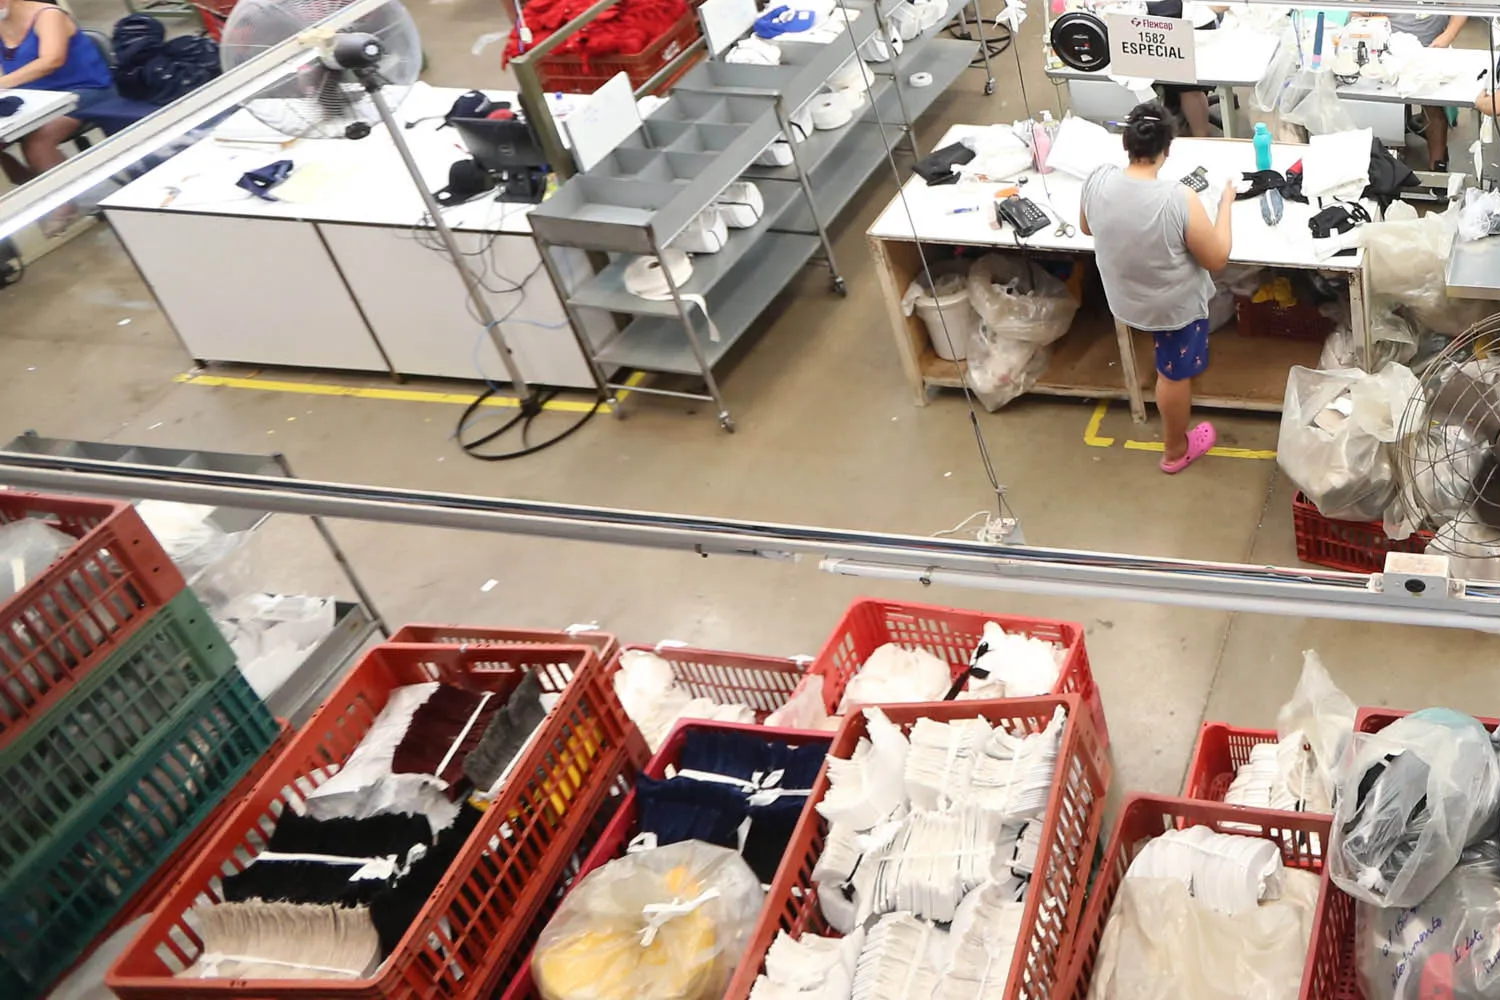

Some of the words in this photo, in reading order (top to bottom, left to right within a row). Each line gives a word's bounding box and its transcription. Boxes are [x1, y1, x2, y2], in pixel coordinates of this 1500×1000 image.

[1142, 19, 1173, 31] Flexcap
[1139, 32, 1165, 44] 1582
[1122, 42, 1185, 59] ESPECIAL
